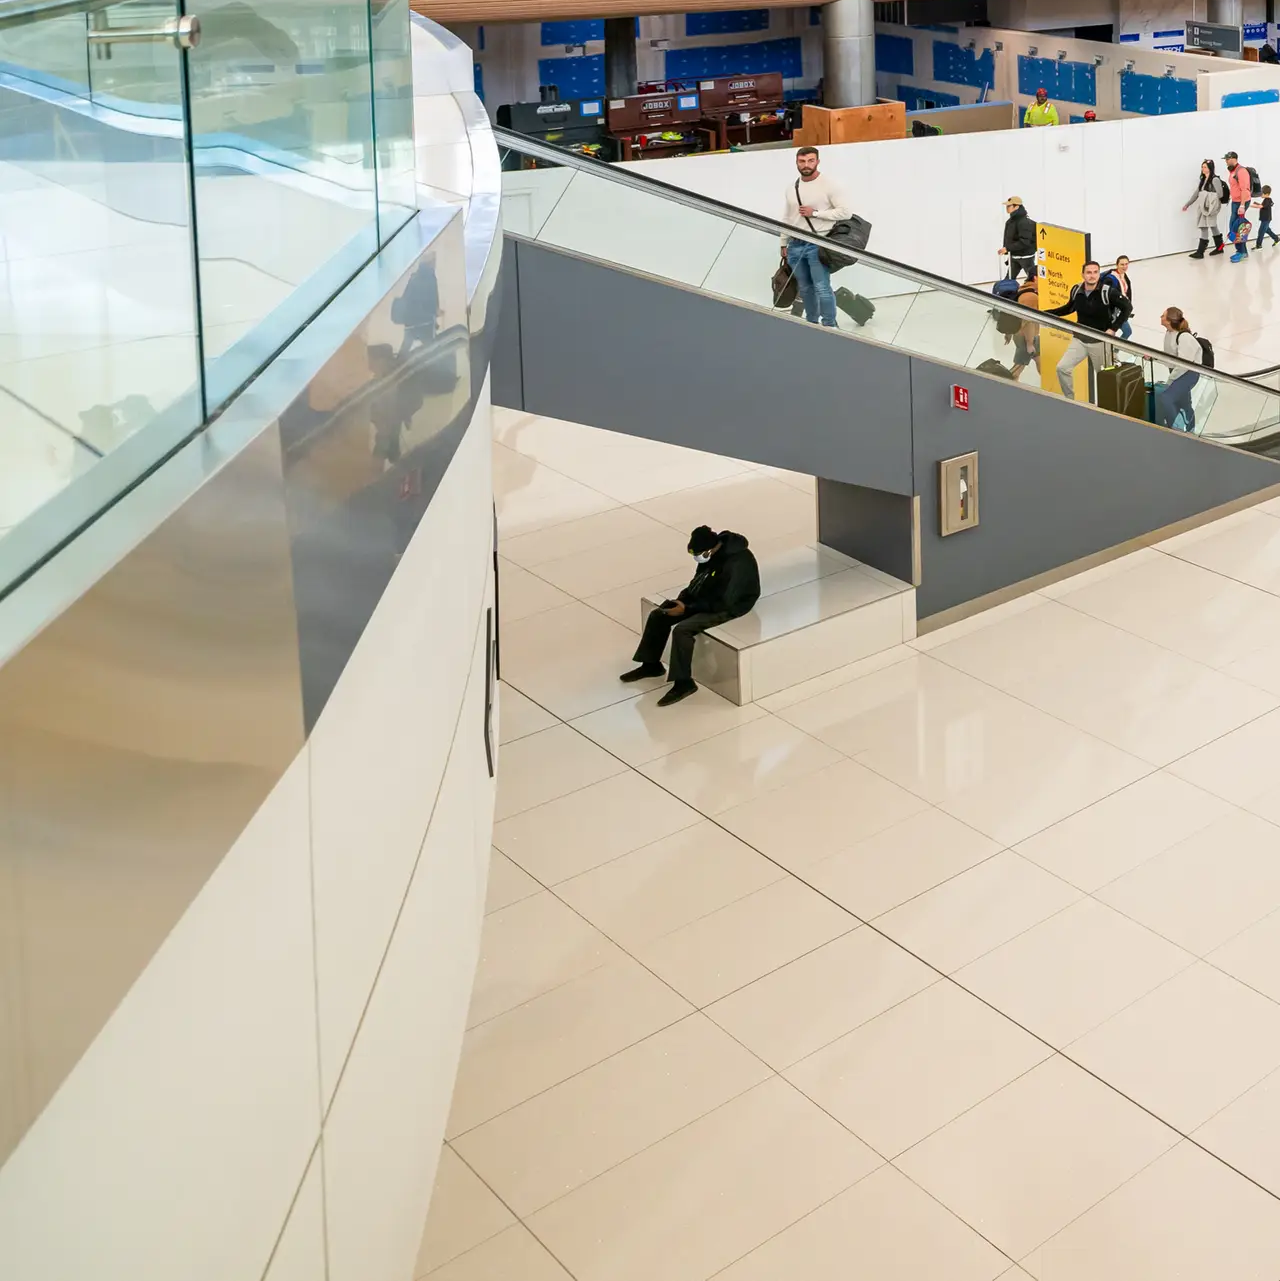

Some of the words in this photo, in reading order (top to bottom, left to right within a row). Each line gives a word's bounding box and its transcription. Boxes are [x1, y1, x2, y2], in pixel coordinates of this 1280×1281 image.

[729, 80, 754, 89] JOBOX
[643, 100, 669, 110] JOBOX
[1047, 251, 1056, 259] All
[1056, 253, 1071, 263] Gates
[1047, 269, 1063, 279] North
[1048, 279, 1069, 292] Security
